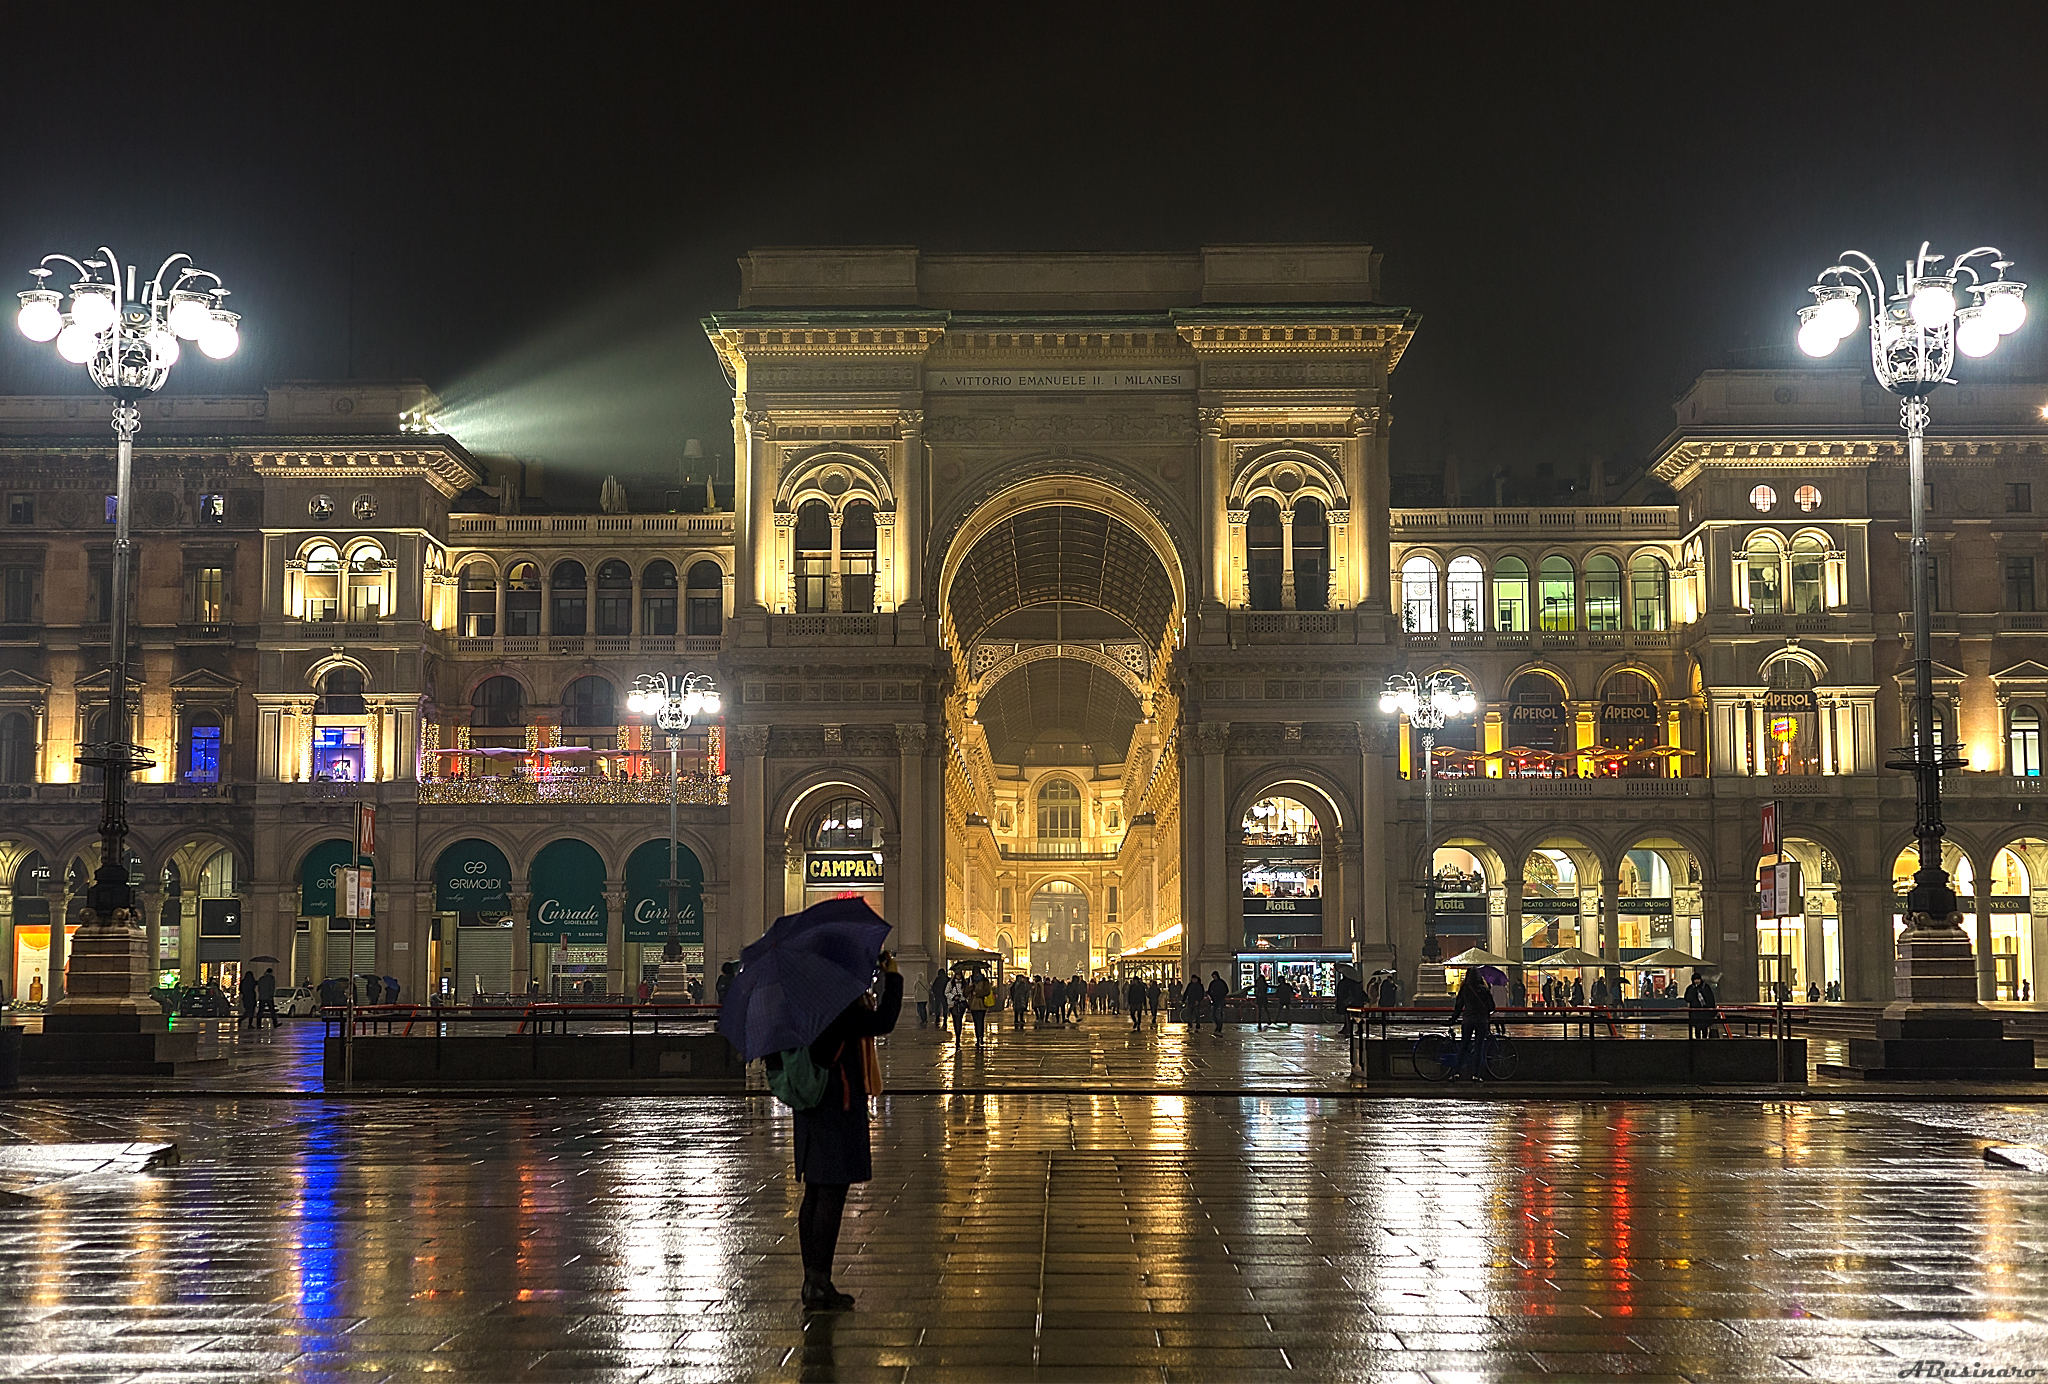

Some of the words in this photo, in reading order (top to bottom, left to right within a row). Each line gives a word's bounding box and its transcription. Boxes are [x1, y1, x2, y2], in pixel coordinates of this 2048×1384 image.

[940, 377, 948, 386] A
[955, 377, 1012, 386] VITTORIO
[1019, 376, 1086, 386] EMANUELE
[1114, 376, 1118, 385] I
[1124, 375, 1181, 385] MILANESI
[1764, 692, 1811, 706] APEROL
[1513, 705, 1558, 719] APEROL
[1604, 705, 1650, 719] APEROL
[362, 816, 373, 845] M
[1763, 815, 1774, 844] M
[809, 860, 883, 877] CAMPARI
[449, 879, 501, 889] GRIMOLDI
[538, 899, 599, 925] Currado
[634, 898, 695, 924] Currdo
[1265, 900, 1296, 911] Motta
[1434, 900, 1465, 910] Motta
